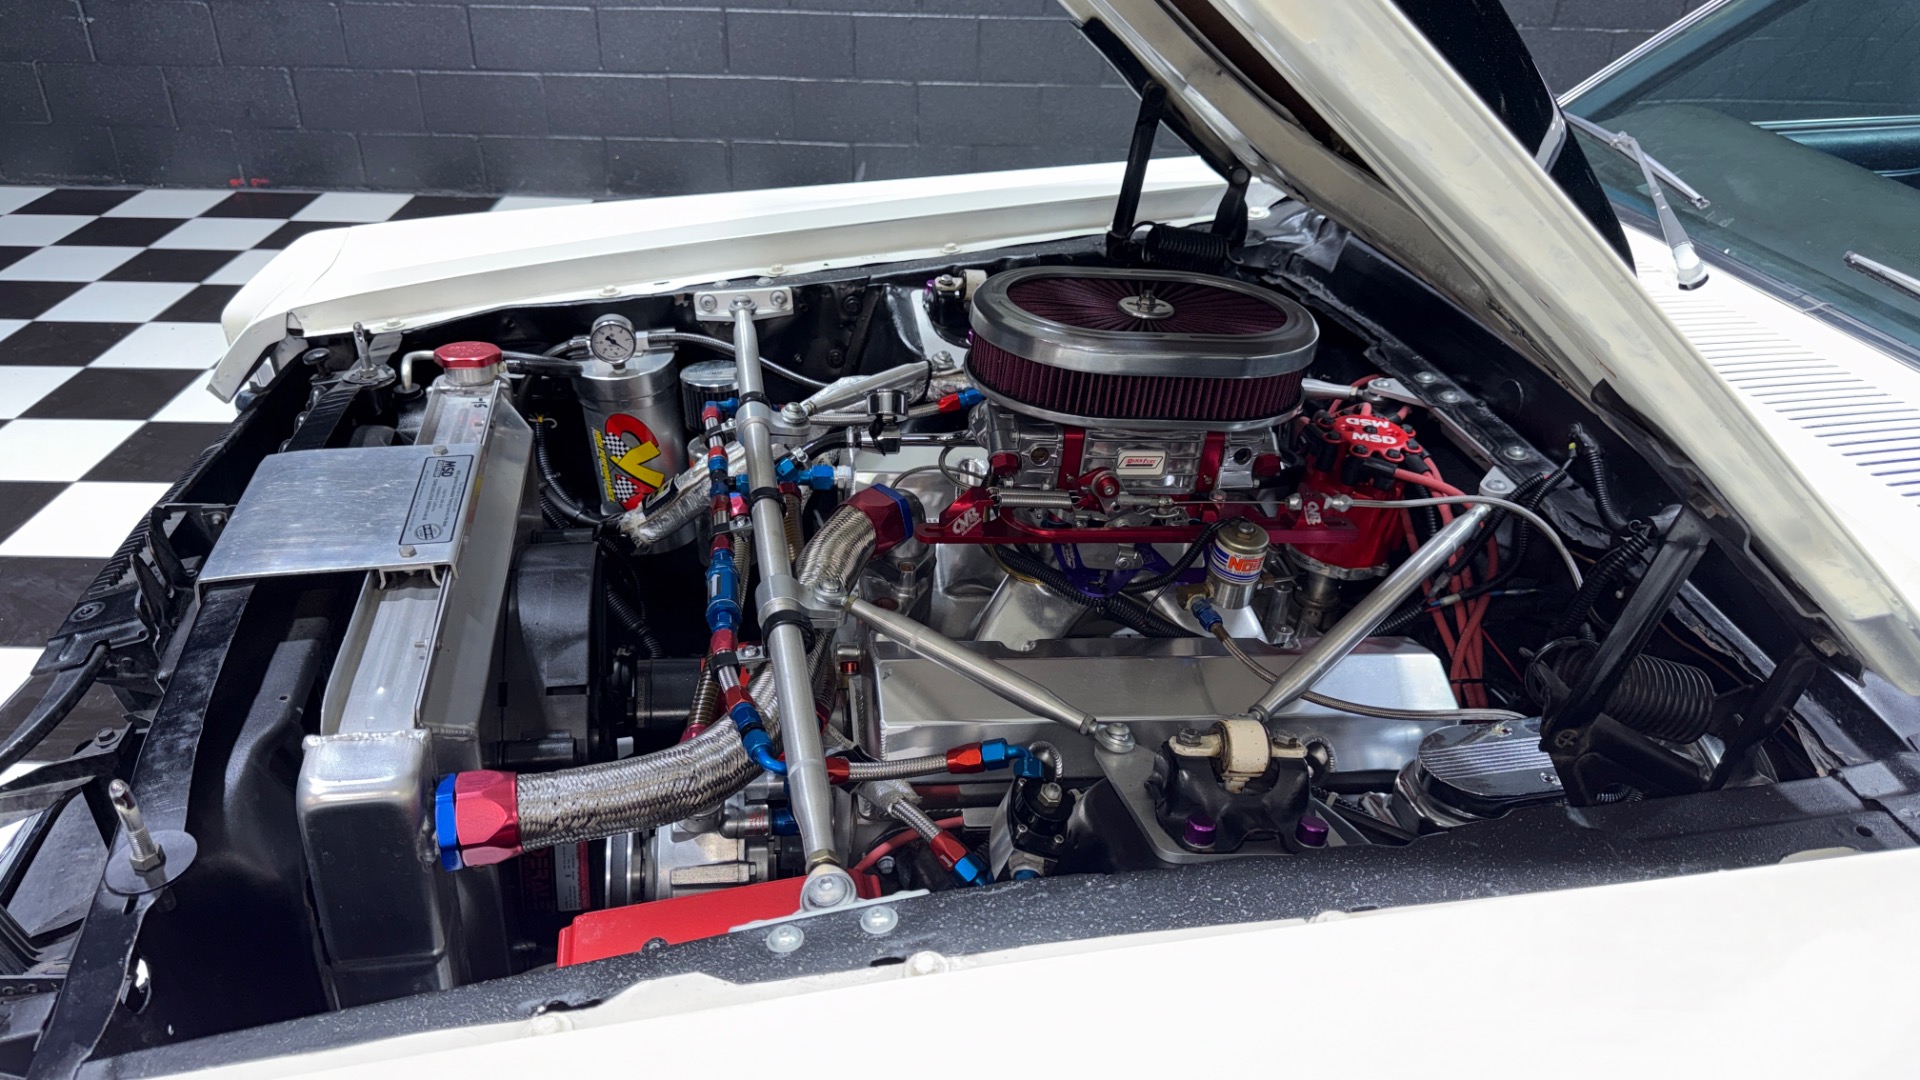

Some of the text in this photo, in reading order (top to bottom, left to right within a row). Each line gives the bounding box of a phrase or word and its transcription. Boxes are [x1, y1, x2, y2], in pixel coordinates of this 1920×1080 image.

[1345, 417, 1390, 429] MSD
[1352, 432, 1397, 445] MSD
[441, 460, 457, 478] MSD
[952, 507, 980, 535] CVR
